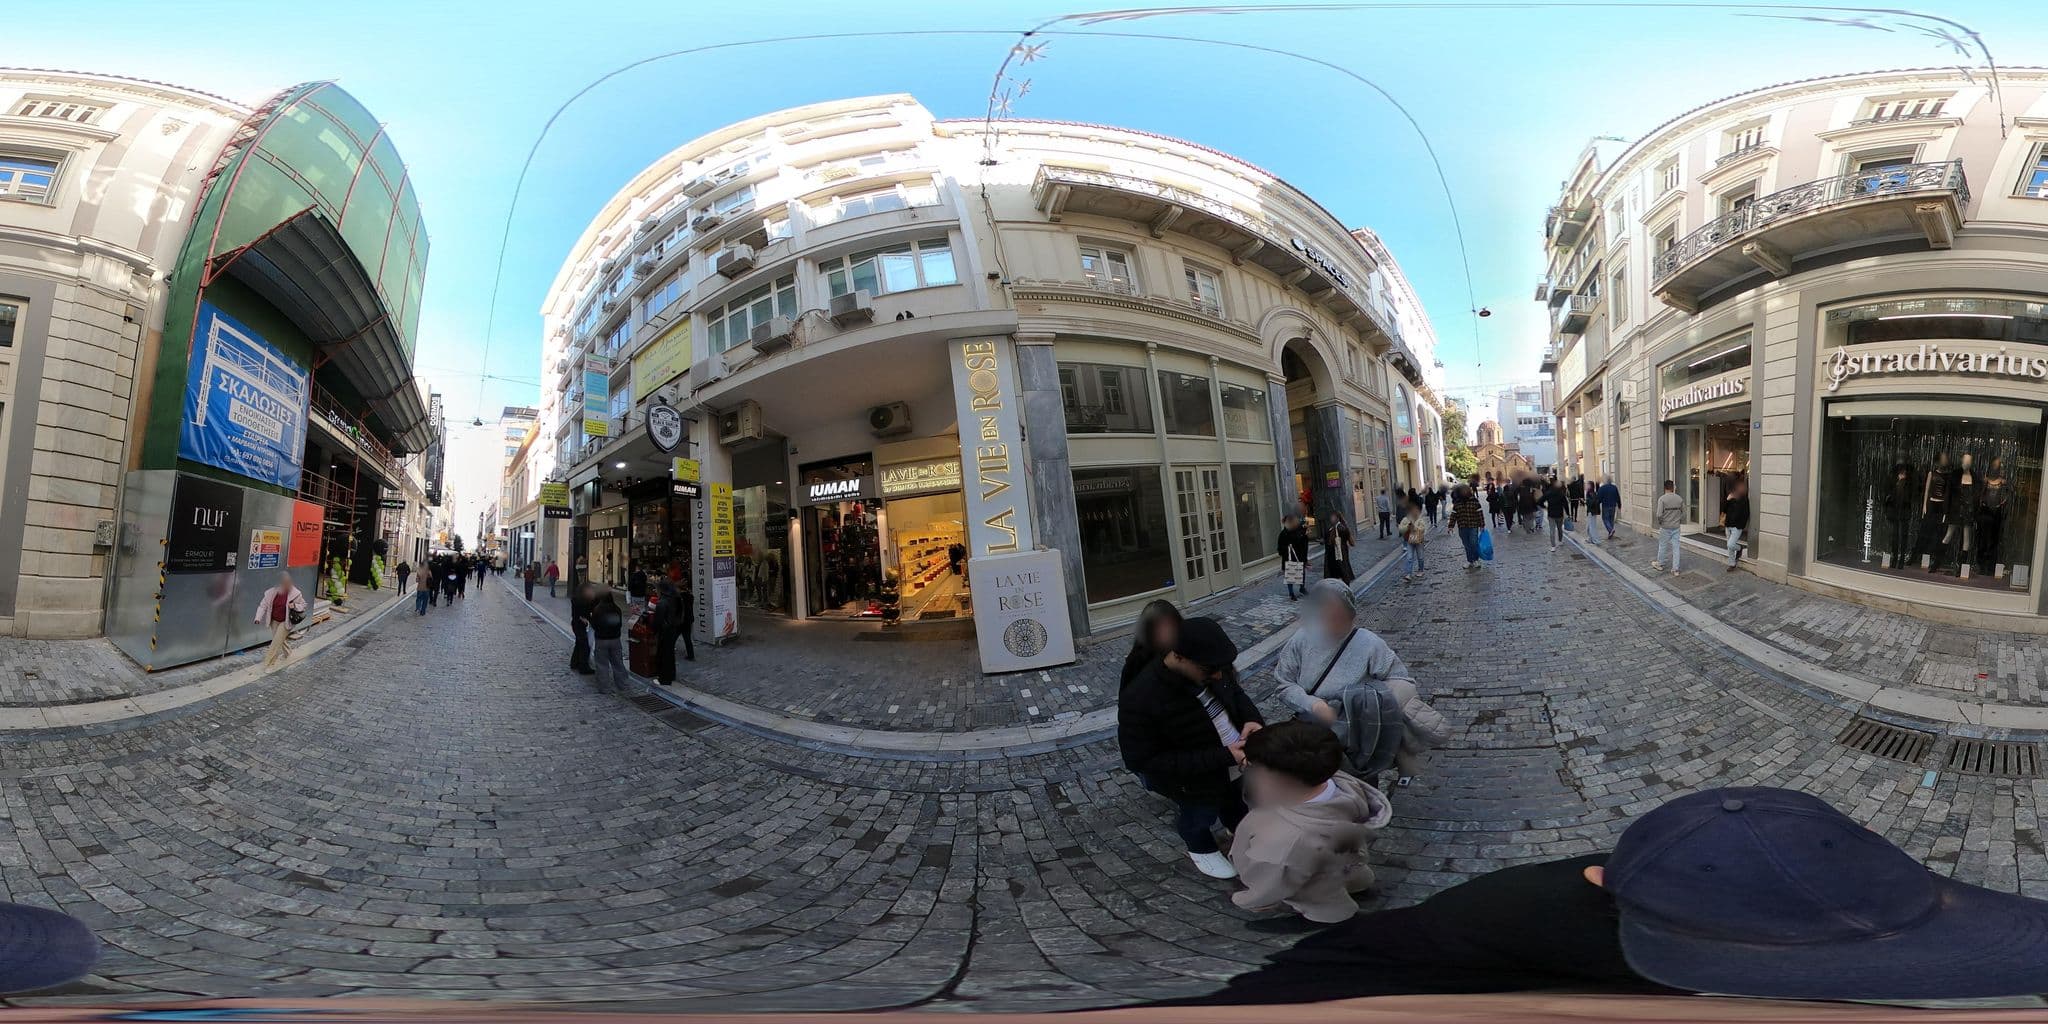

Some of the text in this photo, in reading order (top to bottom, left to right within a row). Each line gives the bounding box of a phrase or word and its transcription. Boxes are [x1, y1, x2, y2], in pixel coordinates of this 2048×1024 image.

[1847, 344, 2048, 379] stradivarius
[219, 372, 292, 427] ΣΚΑΛΩΣΙΕΣ
[1666, 377, 1745, 411] stradivarius
[964, 341, 1018, 554] LA VIE EN ROSE
[881, 468, 897, 482] LA
[897, 466, 918, 480] VIE
[928, 461, 960, 477] ROSE
[810, 478, 860, 497] IUMAN
[296, 520, 320, 532] NFP
[594, 529, 614, 538] LYNNE
[996, 571, 1041, 588] LA VIE
[999, 591, 1044, 610] ROSE
